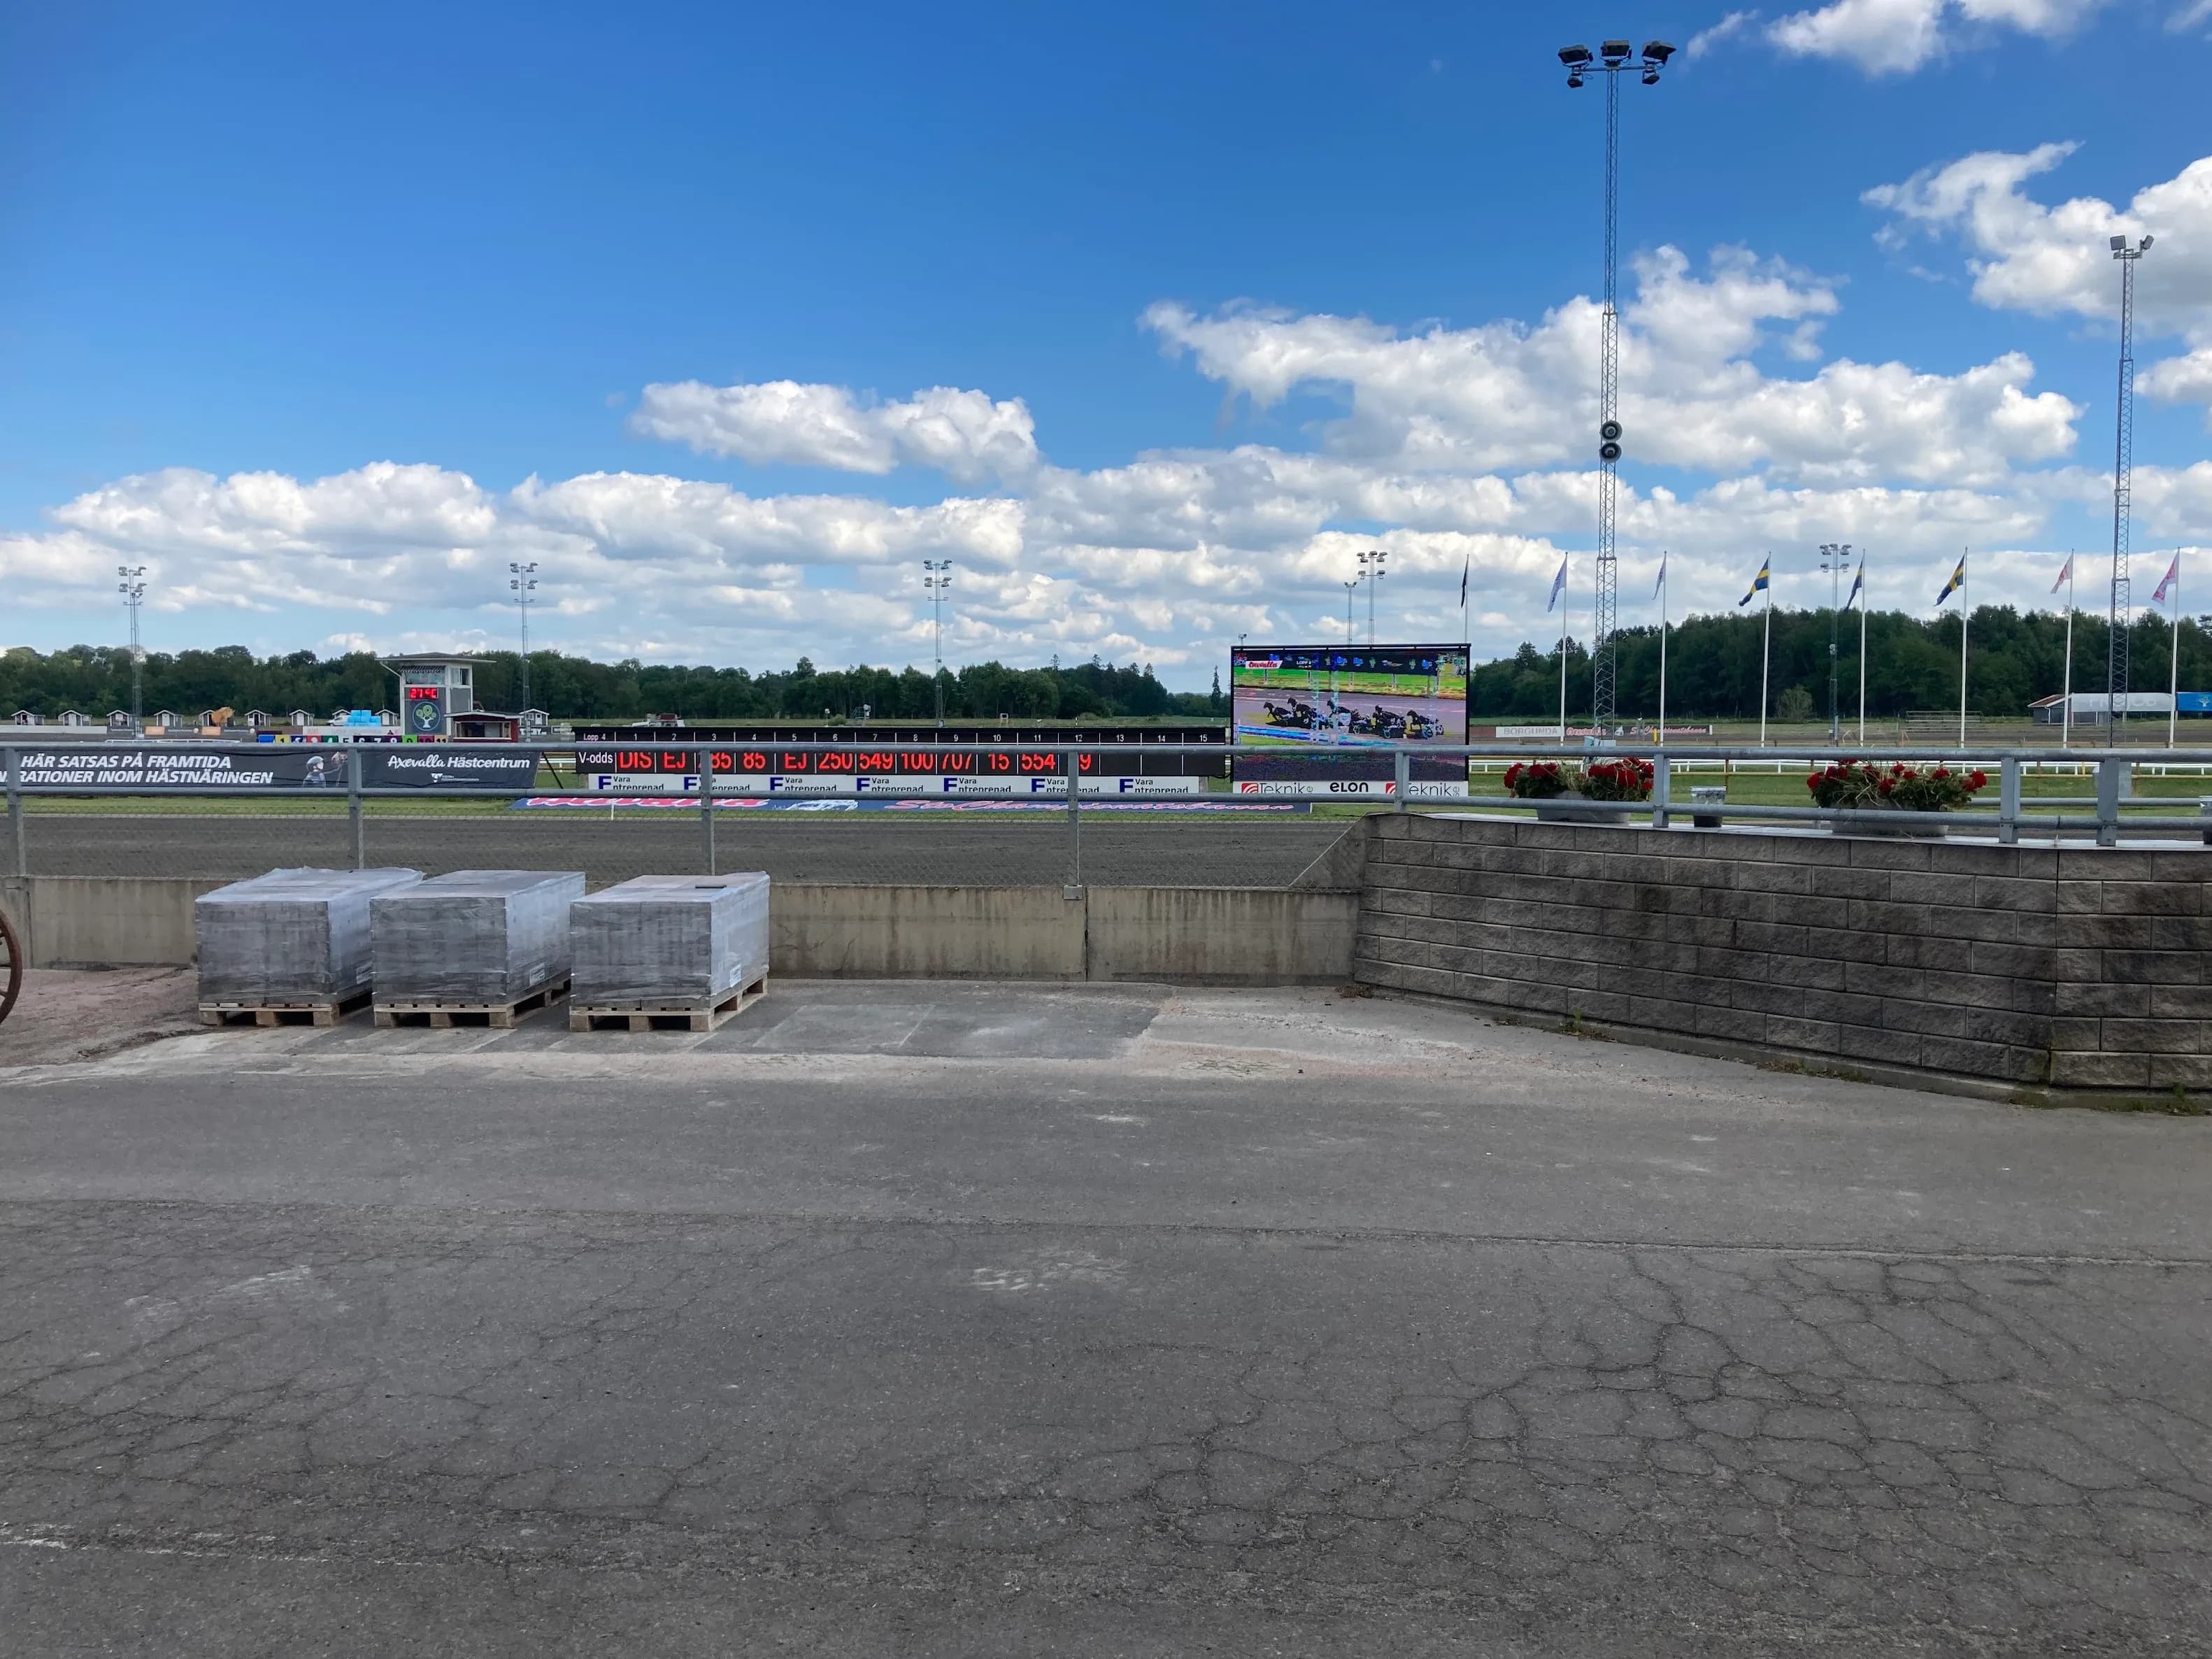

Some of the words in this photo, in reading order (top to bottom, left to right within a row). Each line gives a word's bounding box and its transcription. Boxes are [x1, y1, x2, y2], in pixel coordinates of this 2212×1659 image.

[21, 753, 55, 768] HÄR
[58, 755, 118, 768] SATSAS
[121, 752, 143, 768] PÅ
[146, 755, 231, 769] FRAMTIDA
[387, 754, 445, 769] Axevalla
[447, 756, 530, 769] Hästcentrum
[578, 752, 613, 764] V-odds
[859, 753, 893, 770] 549
[988, 753, 1010, 770] 15
[1022, 753, 1056, 770] 554
[97, 770, 144, 783] INOM
[145, 768, 273, 784] HÄSTNÄRINGEN
[1260, 782, 1305, 794] Teknik
[1408, 783, 1452, 795] eknik
